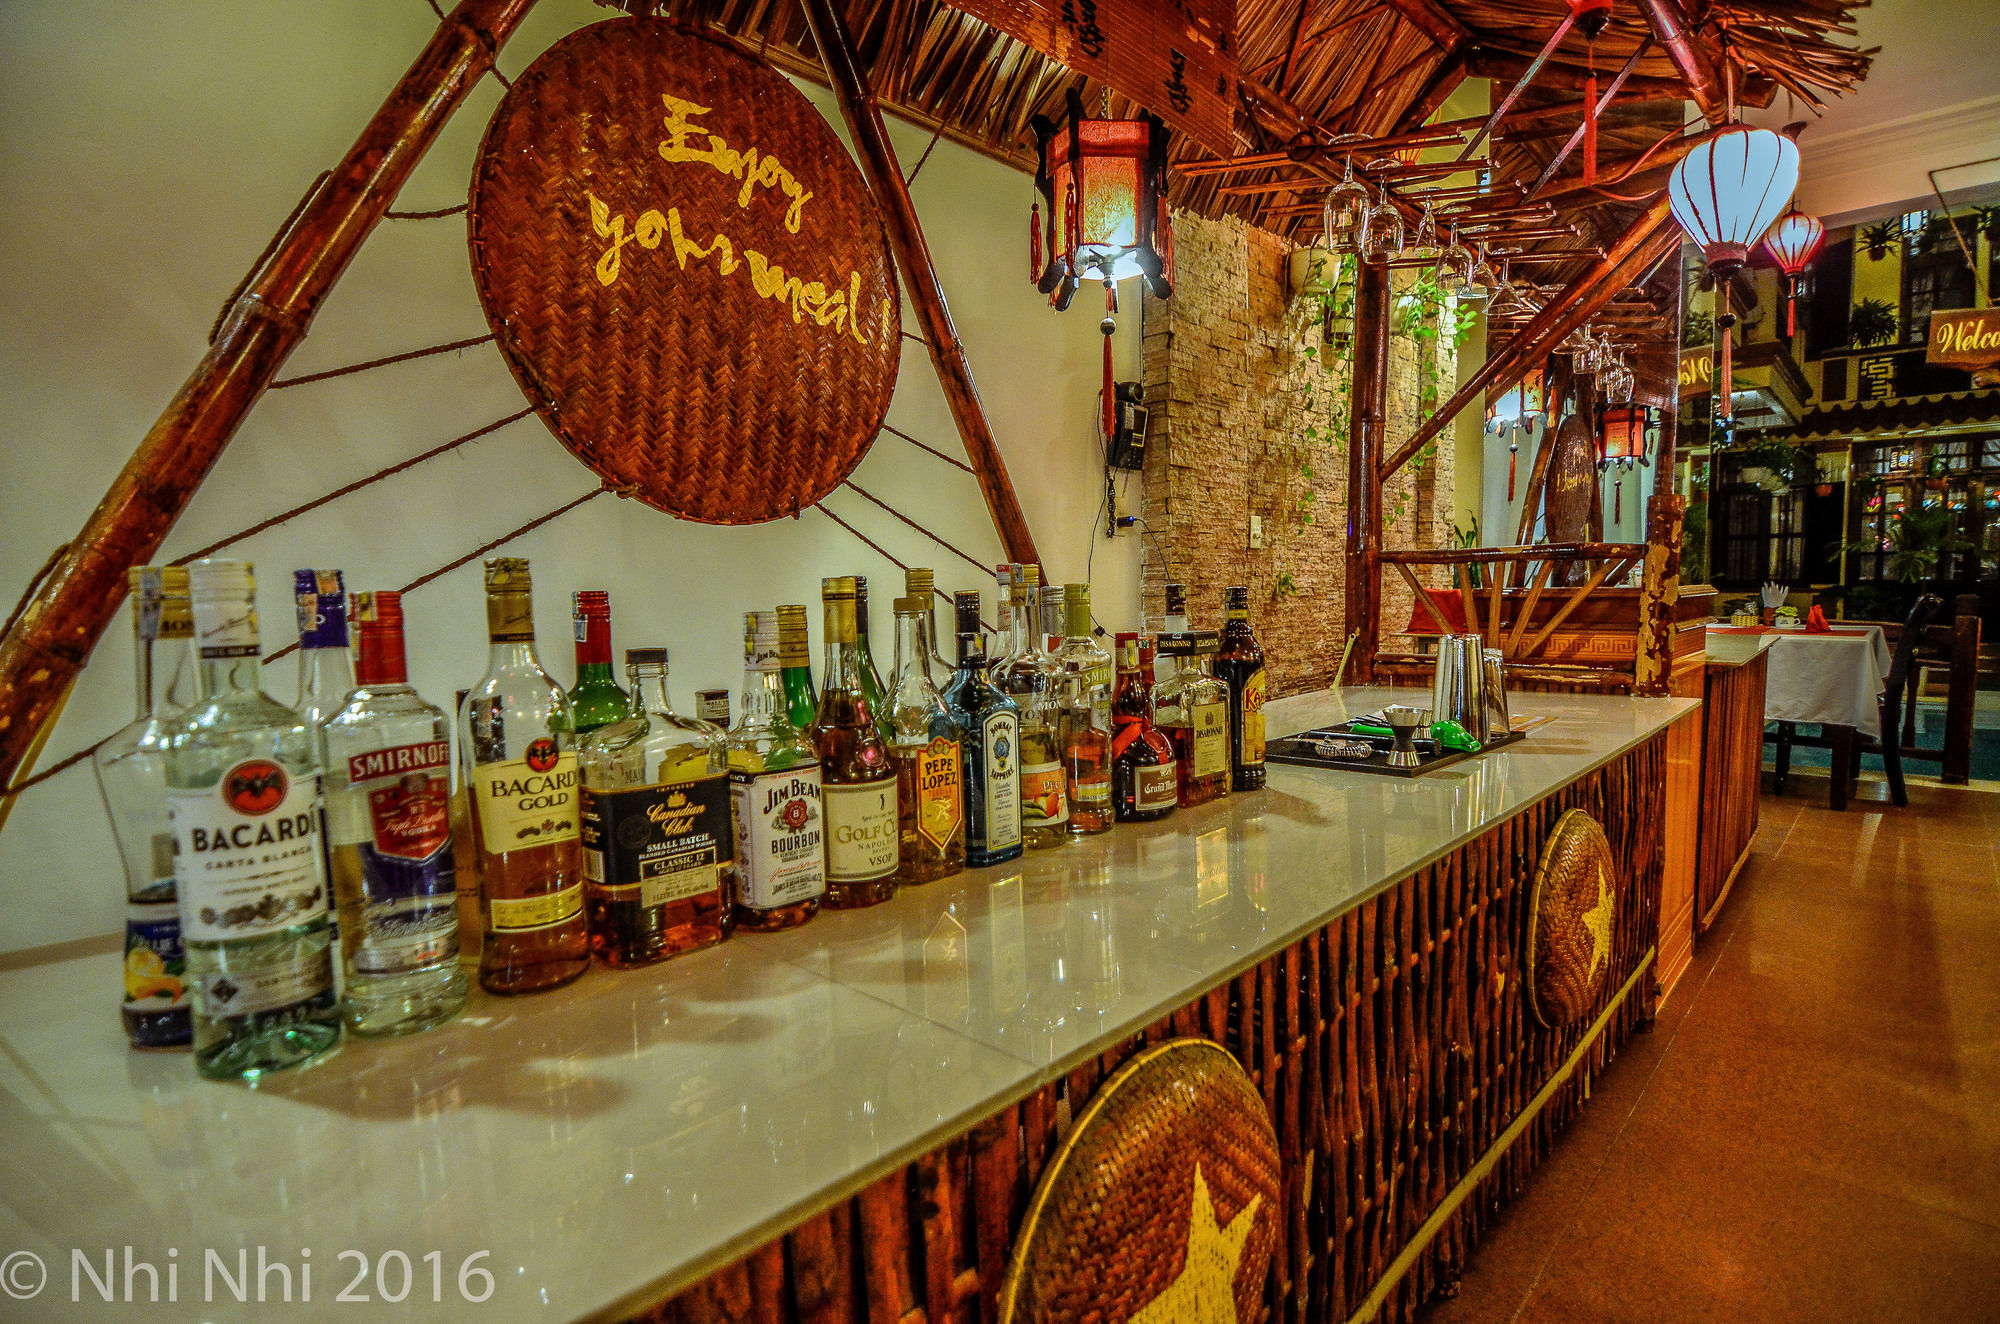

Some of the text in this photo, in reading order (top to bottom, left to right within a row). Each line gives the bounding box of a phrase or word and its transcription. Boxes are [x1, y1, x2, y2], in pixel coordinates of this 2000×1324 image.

[658, 94, 813, 234] Enjoy
[989, 721, 1012, 737] BOMBAY
[1196, 727, 1223, 739] DISARONNO
[925, 758, 953, 776] PEPE
[990, 764, 1015, 780] SAPPHIRE
[922, 771, 957, 790] LOPEZ
[519, 792, 568, 810] GOLD
[763, 784, 789, 815] JIM
[647, 801, 706, 823] Canadian
[646, 832, 710, 854] SMALL BATCH
[771, 829, 820, 854] BOURBON
[654, 854, 694, 871] CLASSIC
[869, 853, 893, 867] VSOP
